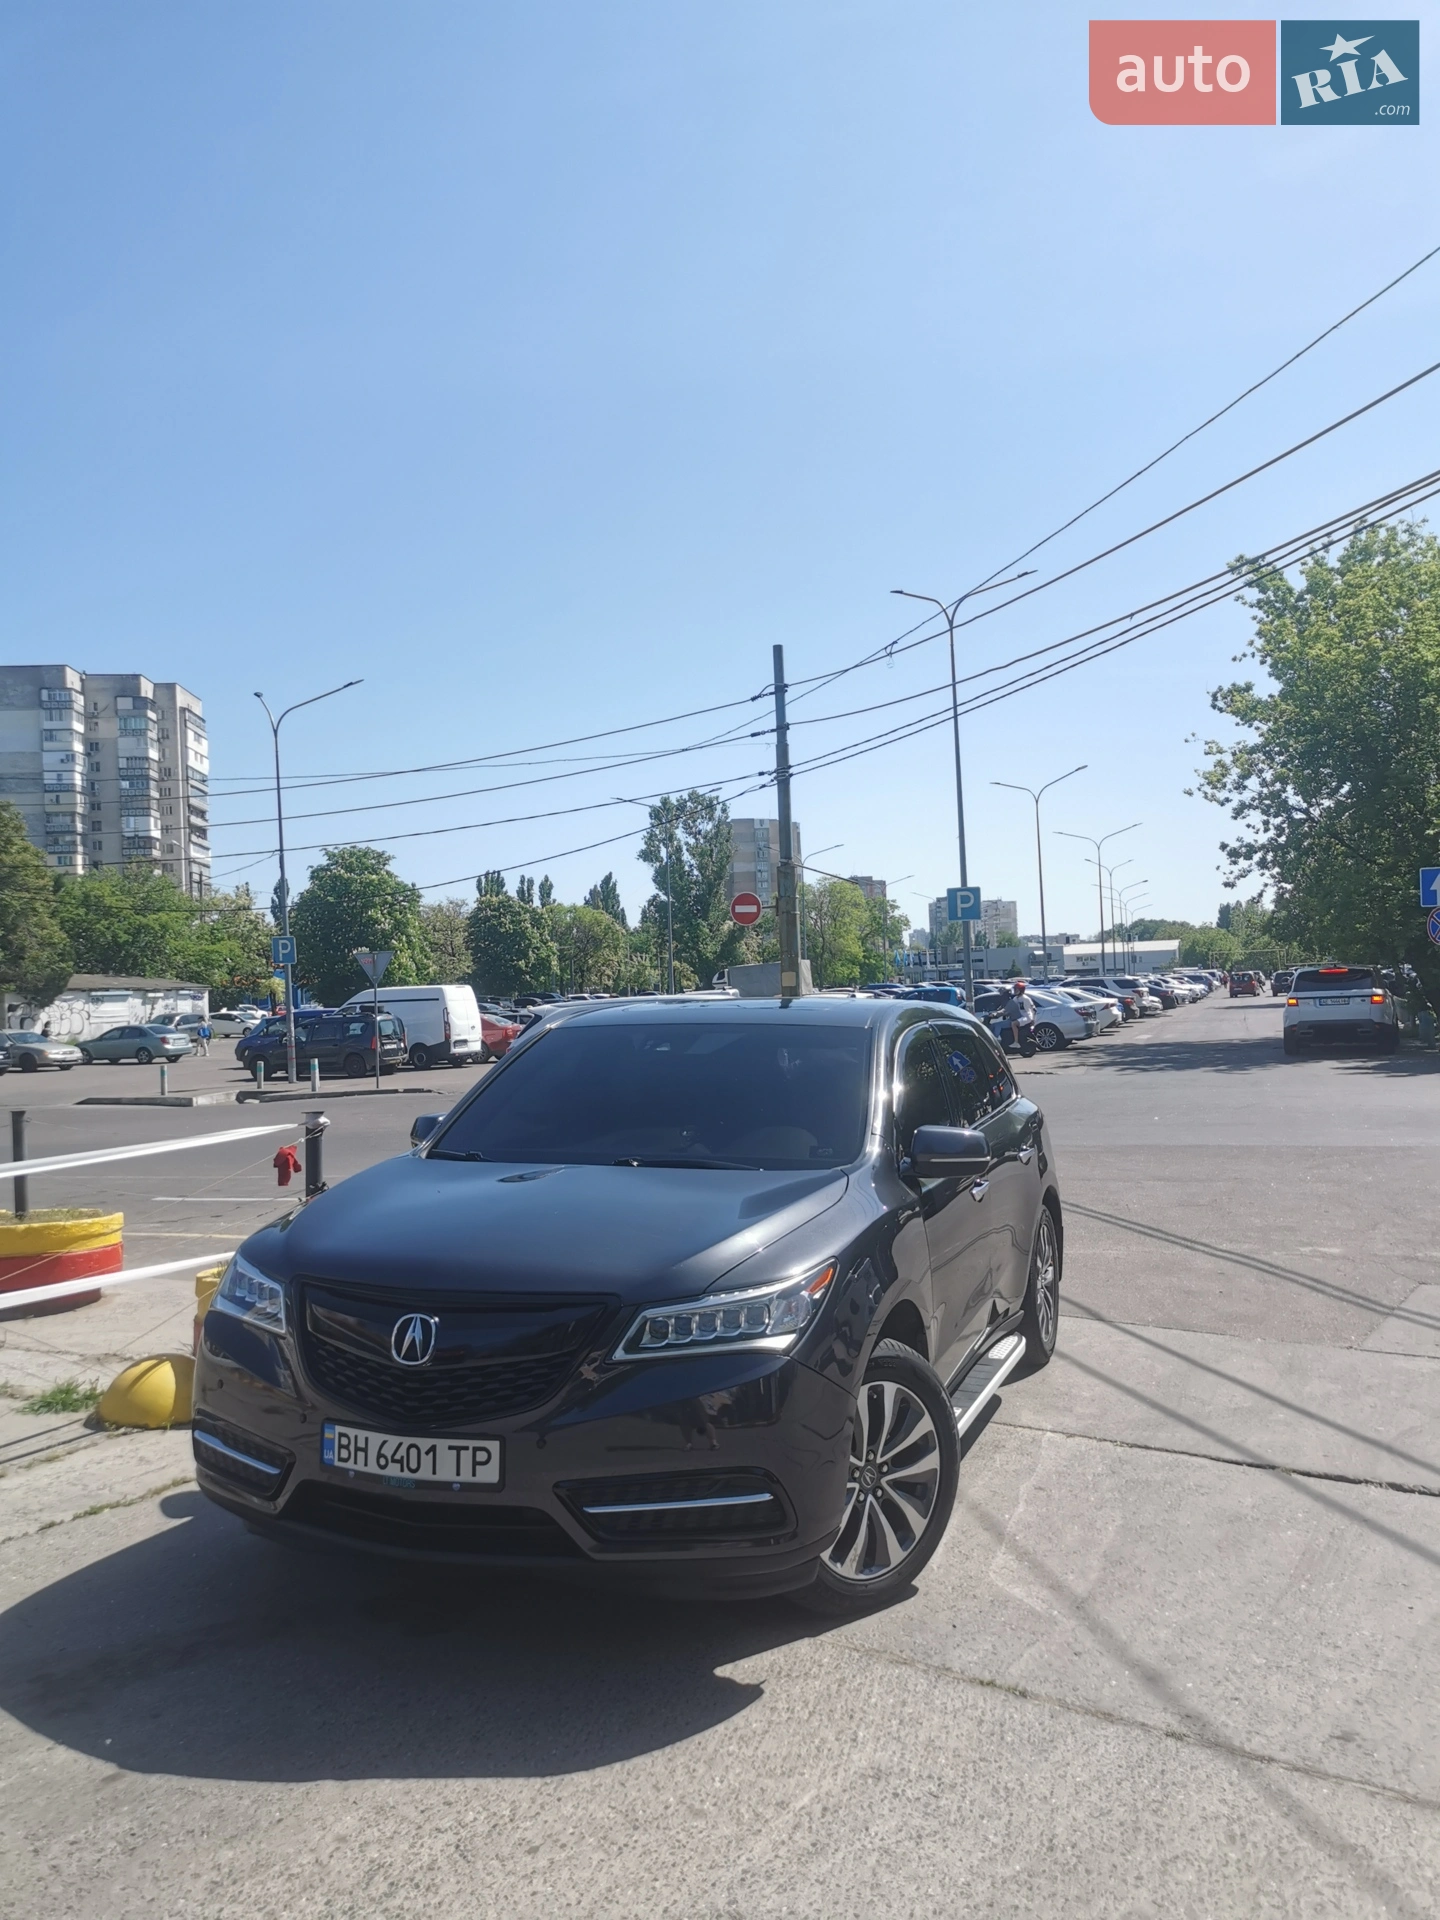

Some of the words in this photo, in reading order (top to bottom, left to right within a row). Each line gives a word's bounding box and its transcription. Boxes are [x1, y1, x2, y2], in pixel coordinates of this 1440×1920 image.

[956, 891, 975, 917] P
[279, 940, 291, 961] P
[323, 1449, 334, 1460] UA
[337, 1431, 369, 1467] BH
[376, 1439, 437, 1476] 6401
[448, 1445, 492, 1477] TP
